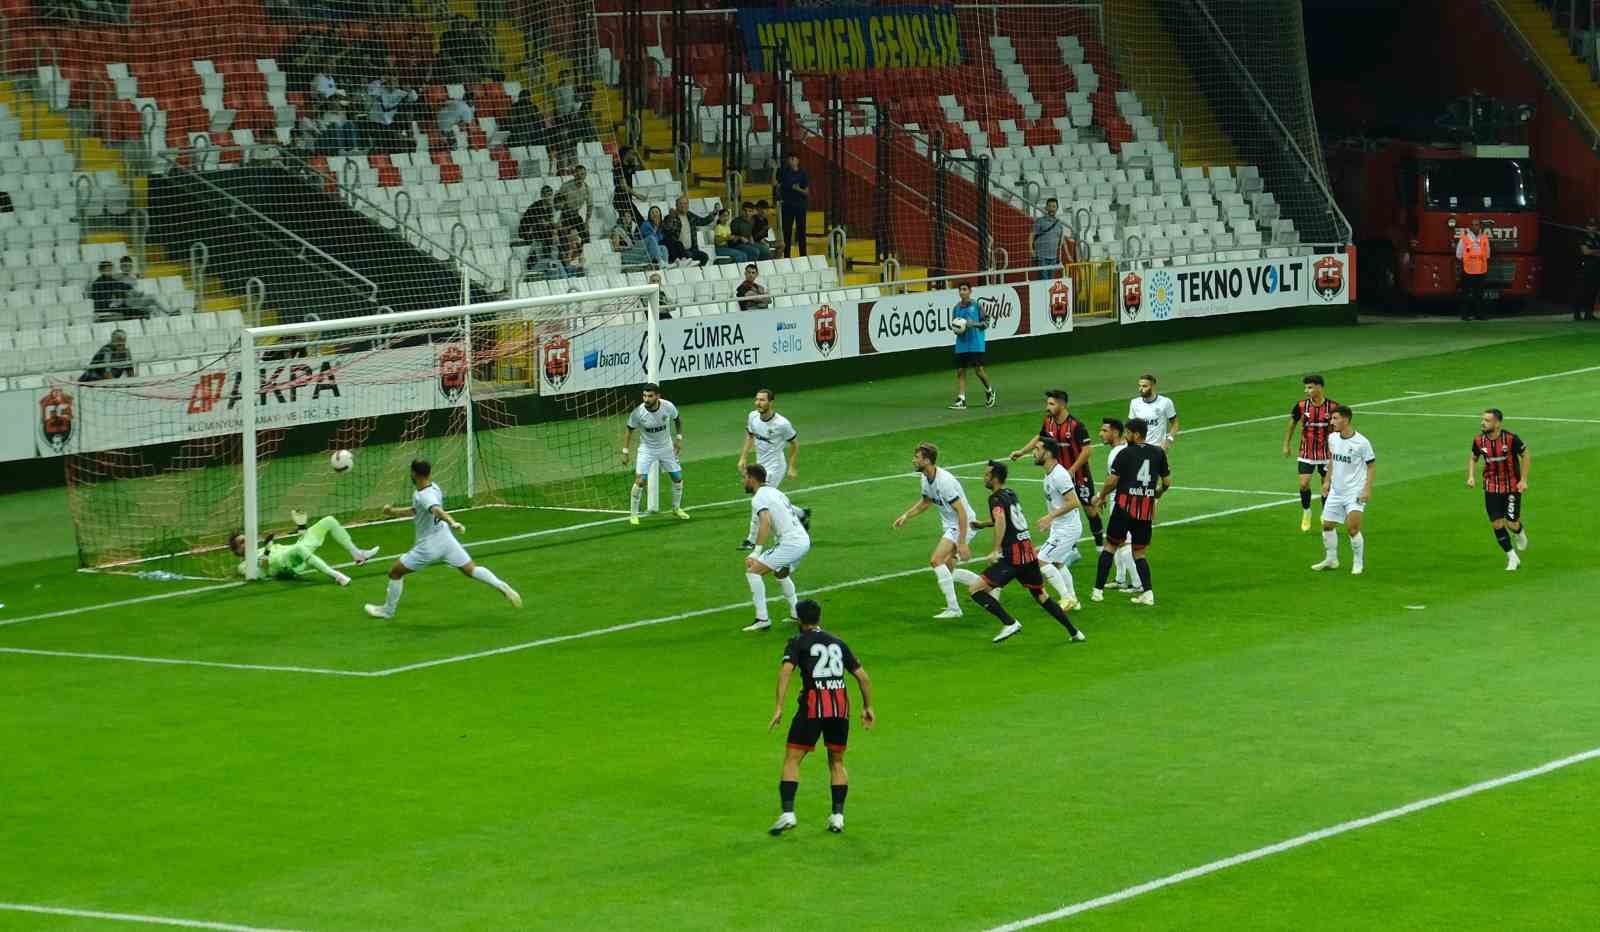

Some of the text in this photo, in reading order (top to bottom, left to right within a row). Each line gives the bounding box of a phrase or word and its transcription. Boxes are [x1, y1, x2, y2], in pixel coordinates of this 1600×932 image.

[1177, 267, 1243, 303] TEKNO
[1246, 263, 1303, 295] VOLT
[683, 322, 745, 350] ZÜMRA
[772, 335, 802, 354] stella
[599, 350, 630, 368] bianca
[671, 347, 760, 373] YAPI MARKET
[1137, 459, 1151, 487] 4
[810, 643, 844, 679] 28
